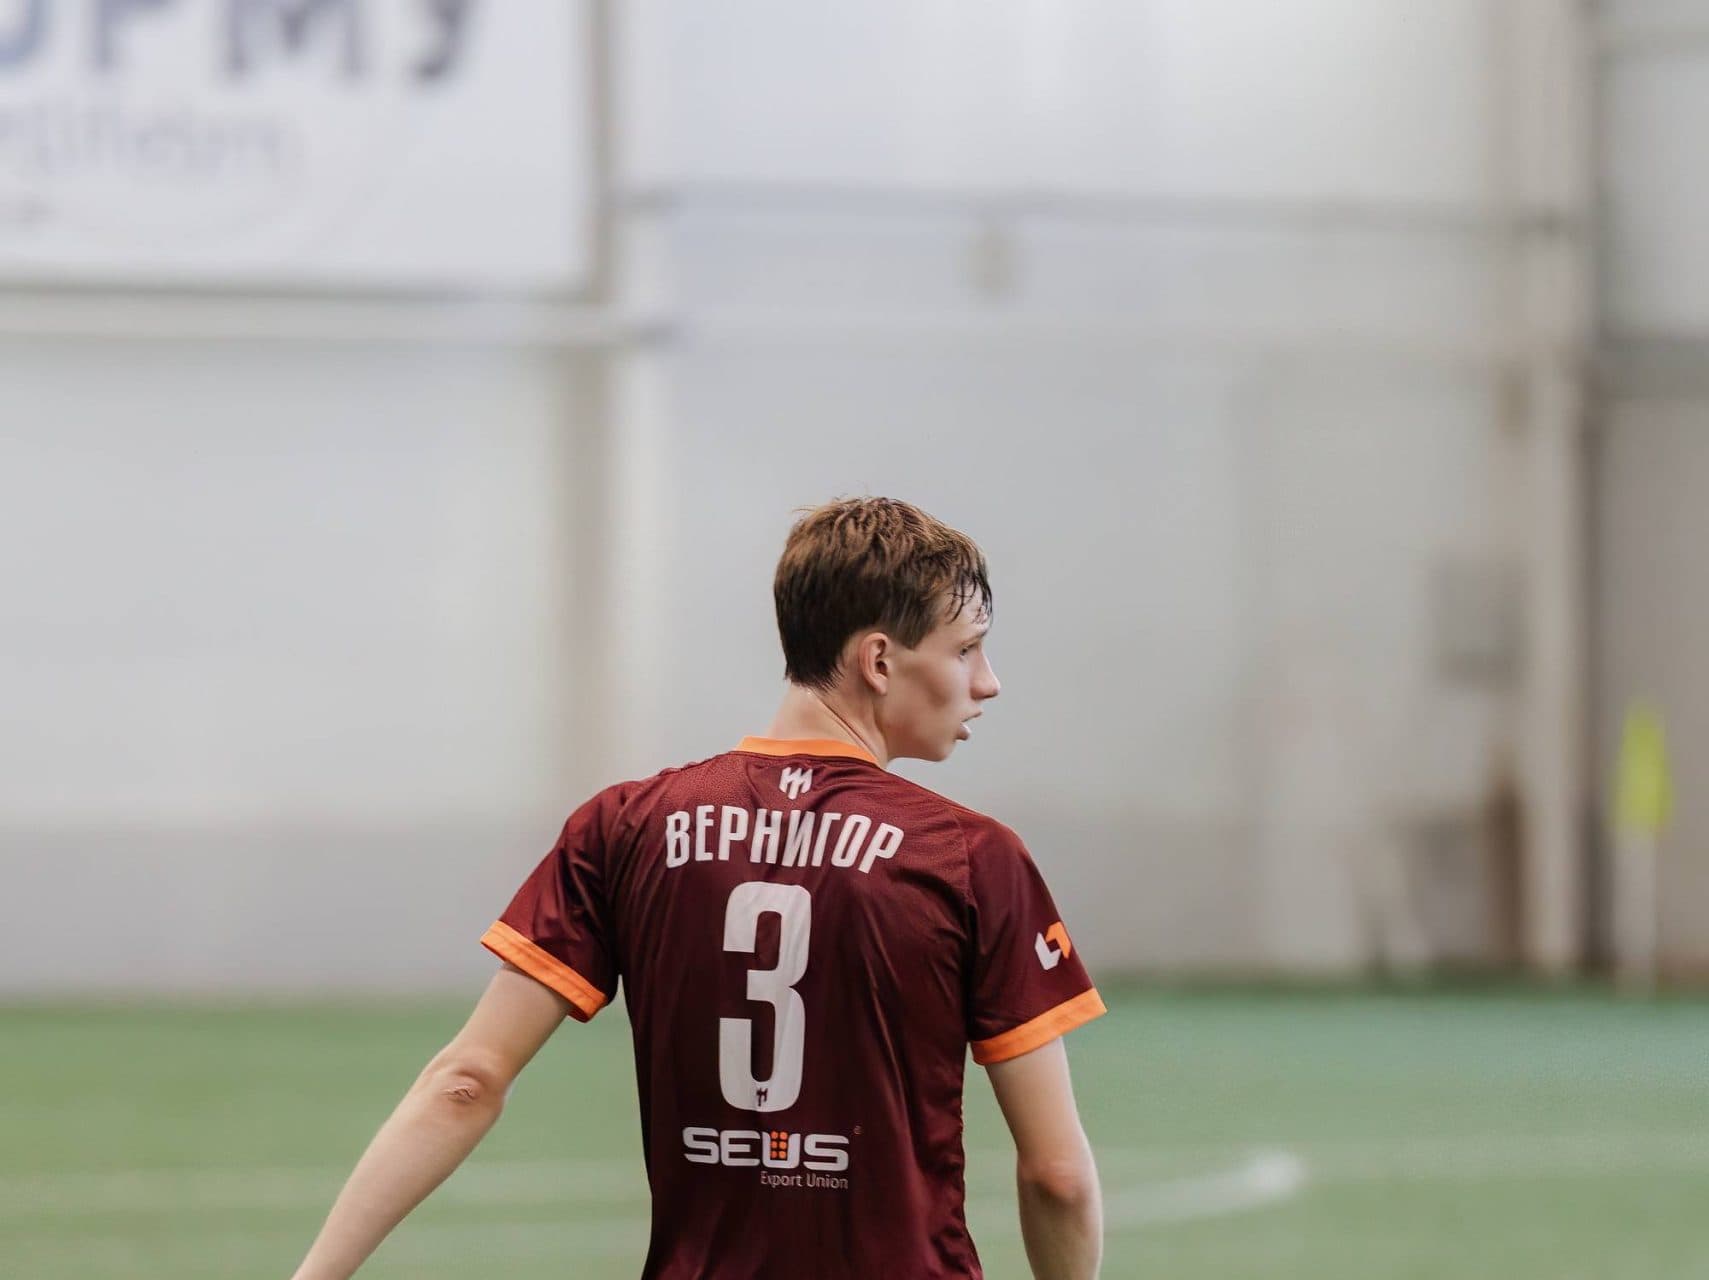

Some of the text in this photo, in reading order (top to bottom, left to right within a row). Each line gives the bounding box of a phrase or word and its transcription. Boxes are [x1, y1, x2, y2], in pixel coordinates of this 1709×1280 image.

[665, 804, 904, 874] ВЕРНИГОР
[718, 881, 812, 1113] 3
[682, 1126, 850, 1172] SEUS
[760, 1170, 849, 1190] Export Union
